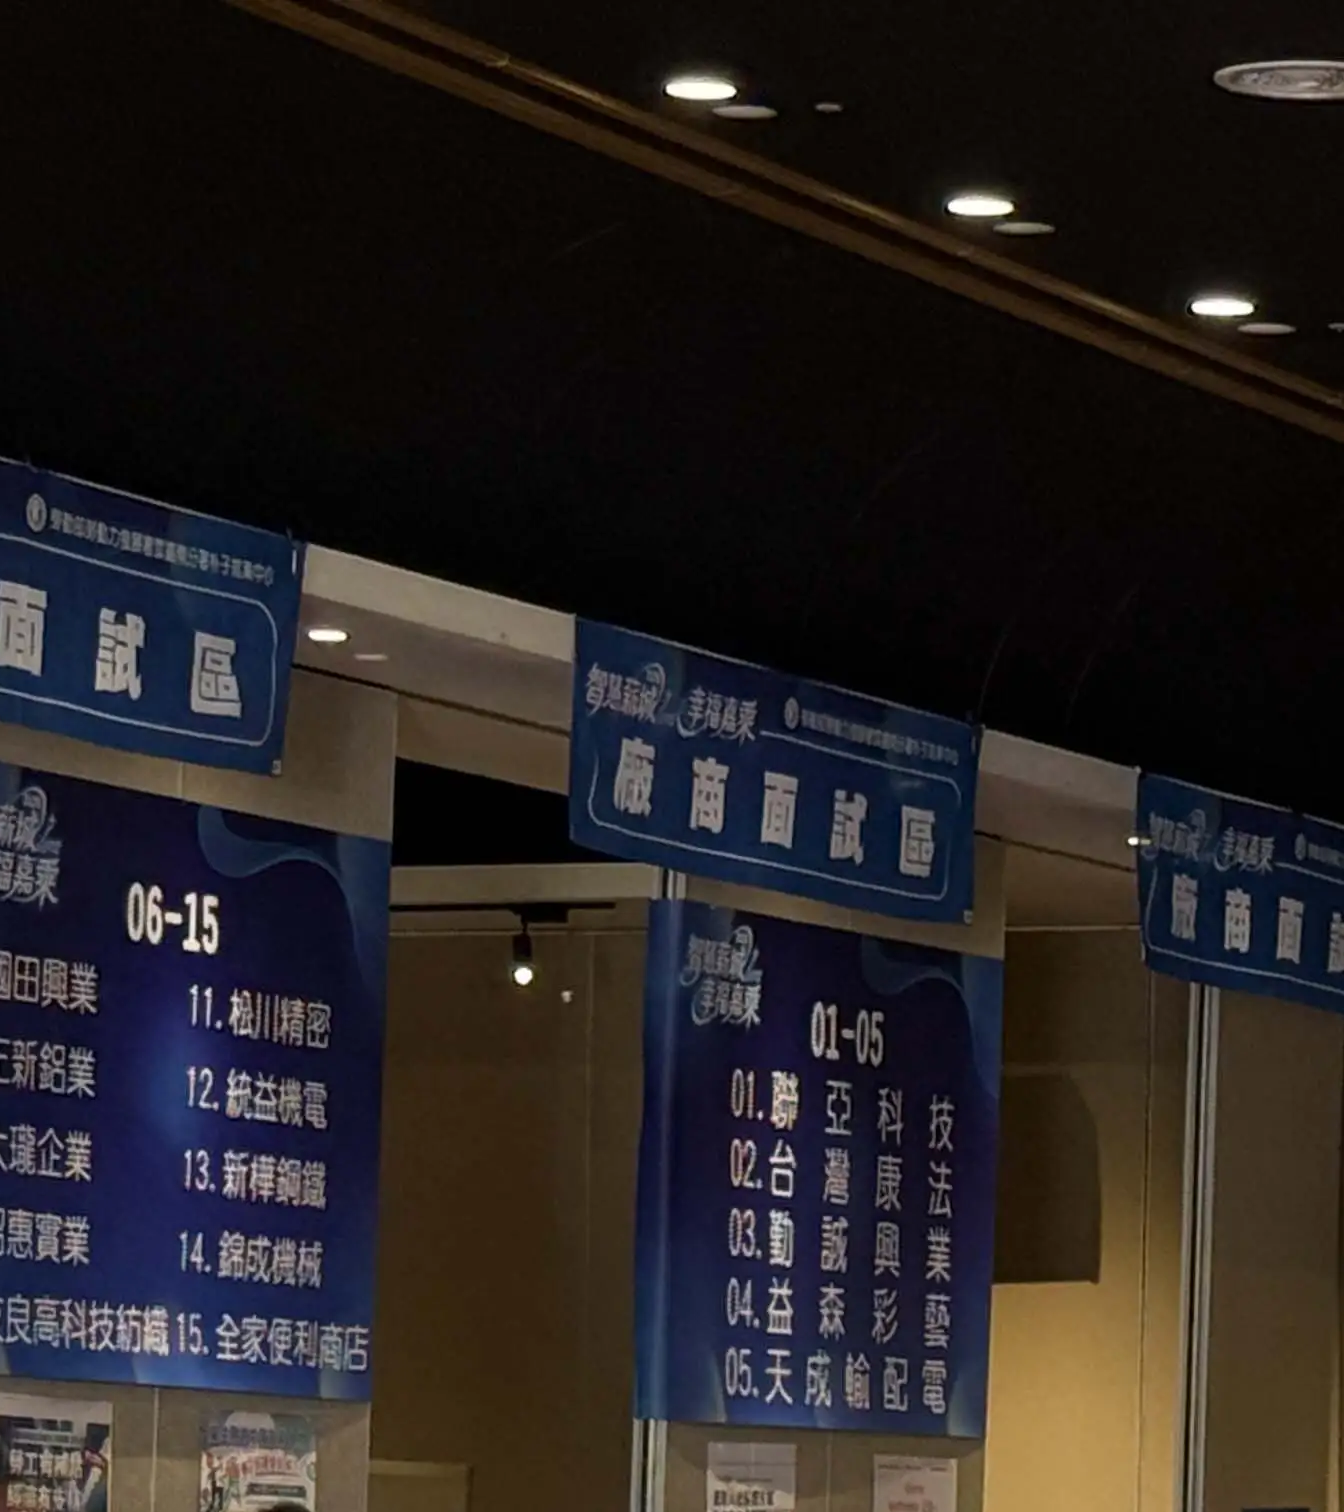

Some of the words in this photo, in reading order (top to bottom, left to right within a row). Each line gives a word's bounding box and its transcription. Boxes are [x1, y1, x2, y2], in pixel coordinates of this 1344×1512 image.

[613, 736, 936, 879] 廠商面試區
[126, 882, 219, 955] 06-15
[810, 1002, 884, 1068] 01-05
[216, 1314, 371, 1373] 全家便利商店
